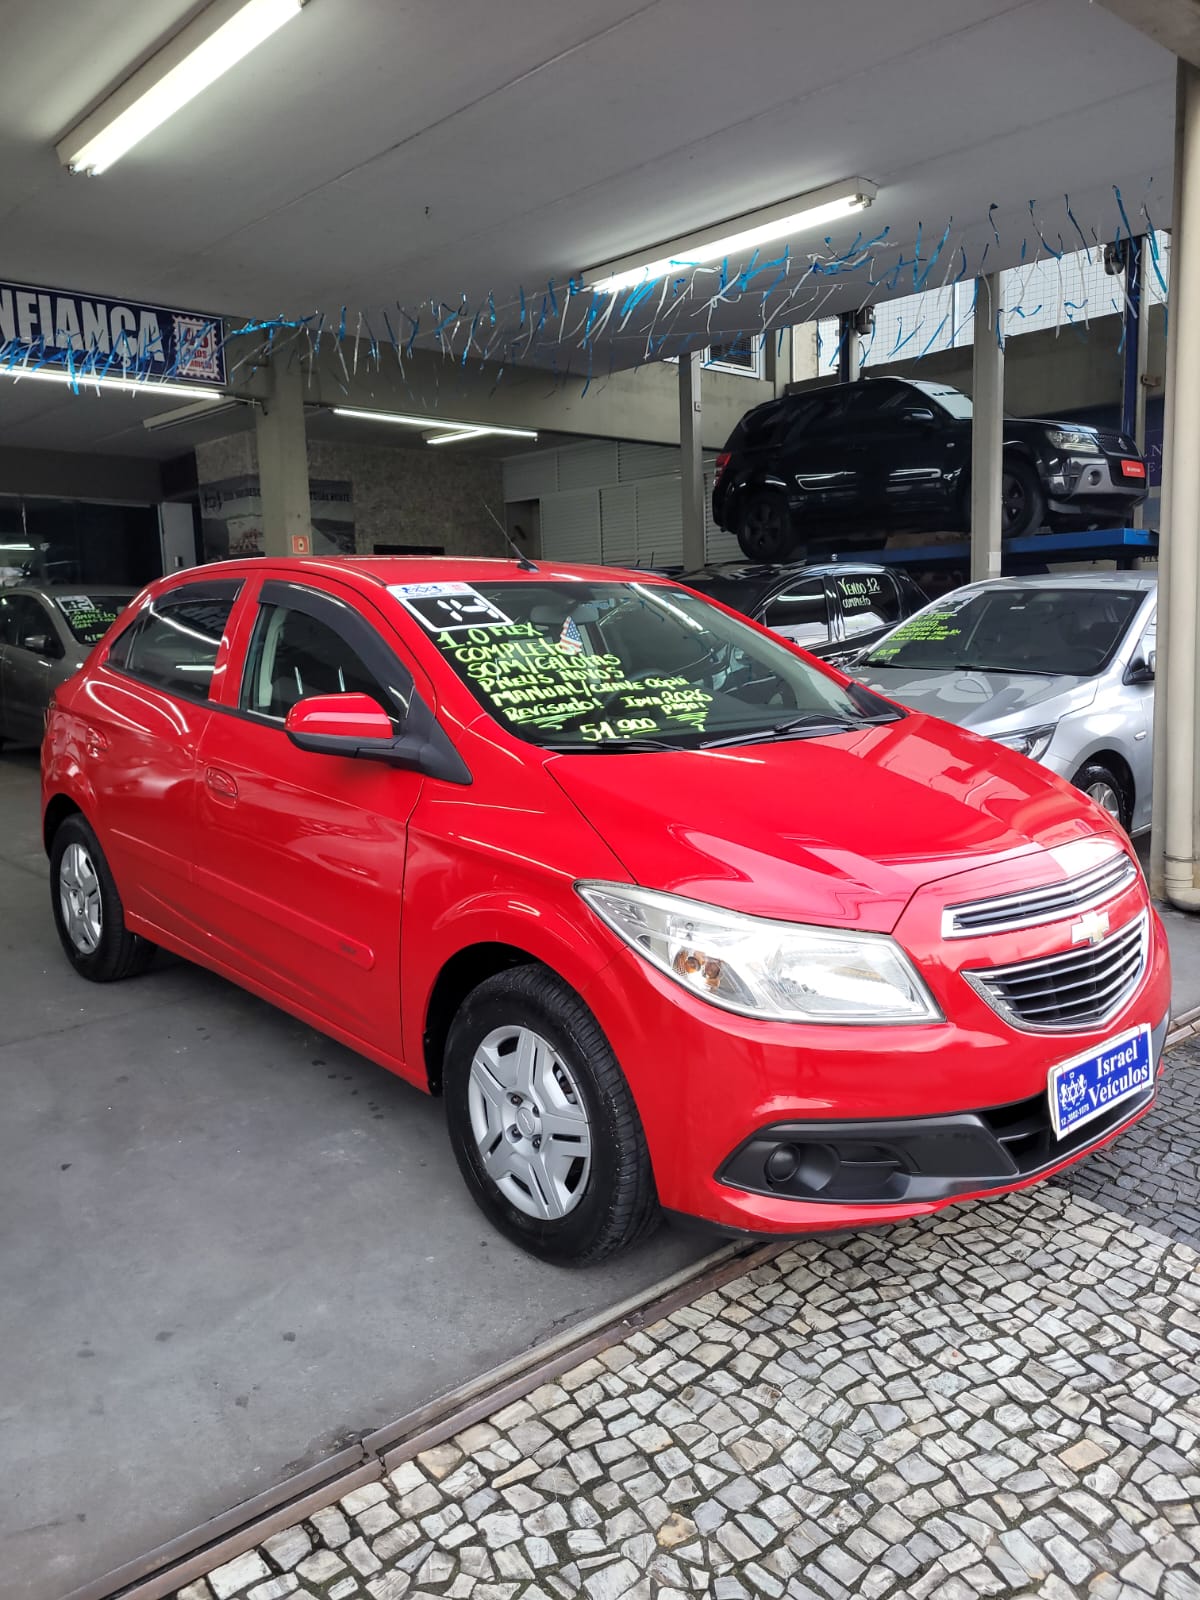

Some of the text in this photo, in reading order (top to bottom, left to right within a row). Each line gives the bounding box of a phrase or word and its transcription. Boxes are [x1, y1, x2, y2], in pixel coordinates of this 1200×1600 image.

[837, 577, 881, 595] VENDO 12
[437, 622, 543, 649] 1.0 FLEX
[477, 666, 625, 692] PNEUS NOVOS
[661, 689, 713, 704] 2026
[579, 718, 657, 741] 51.900
[1096, 1039, 1138, 1079] Israel
[1088, 1064, 1149, 1107] Veículos
